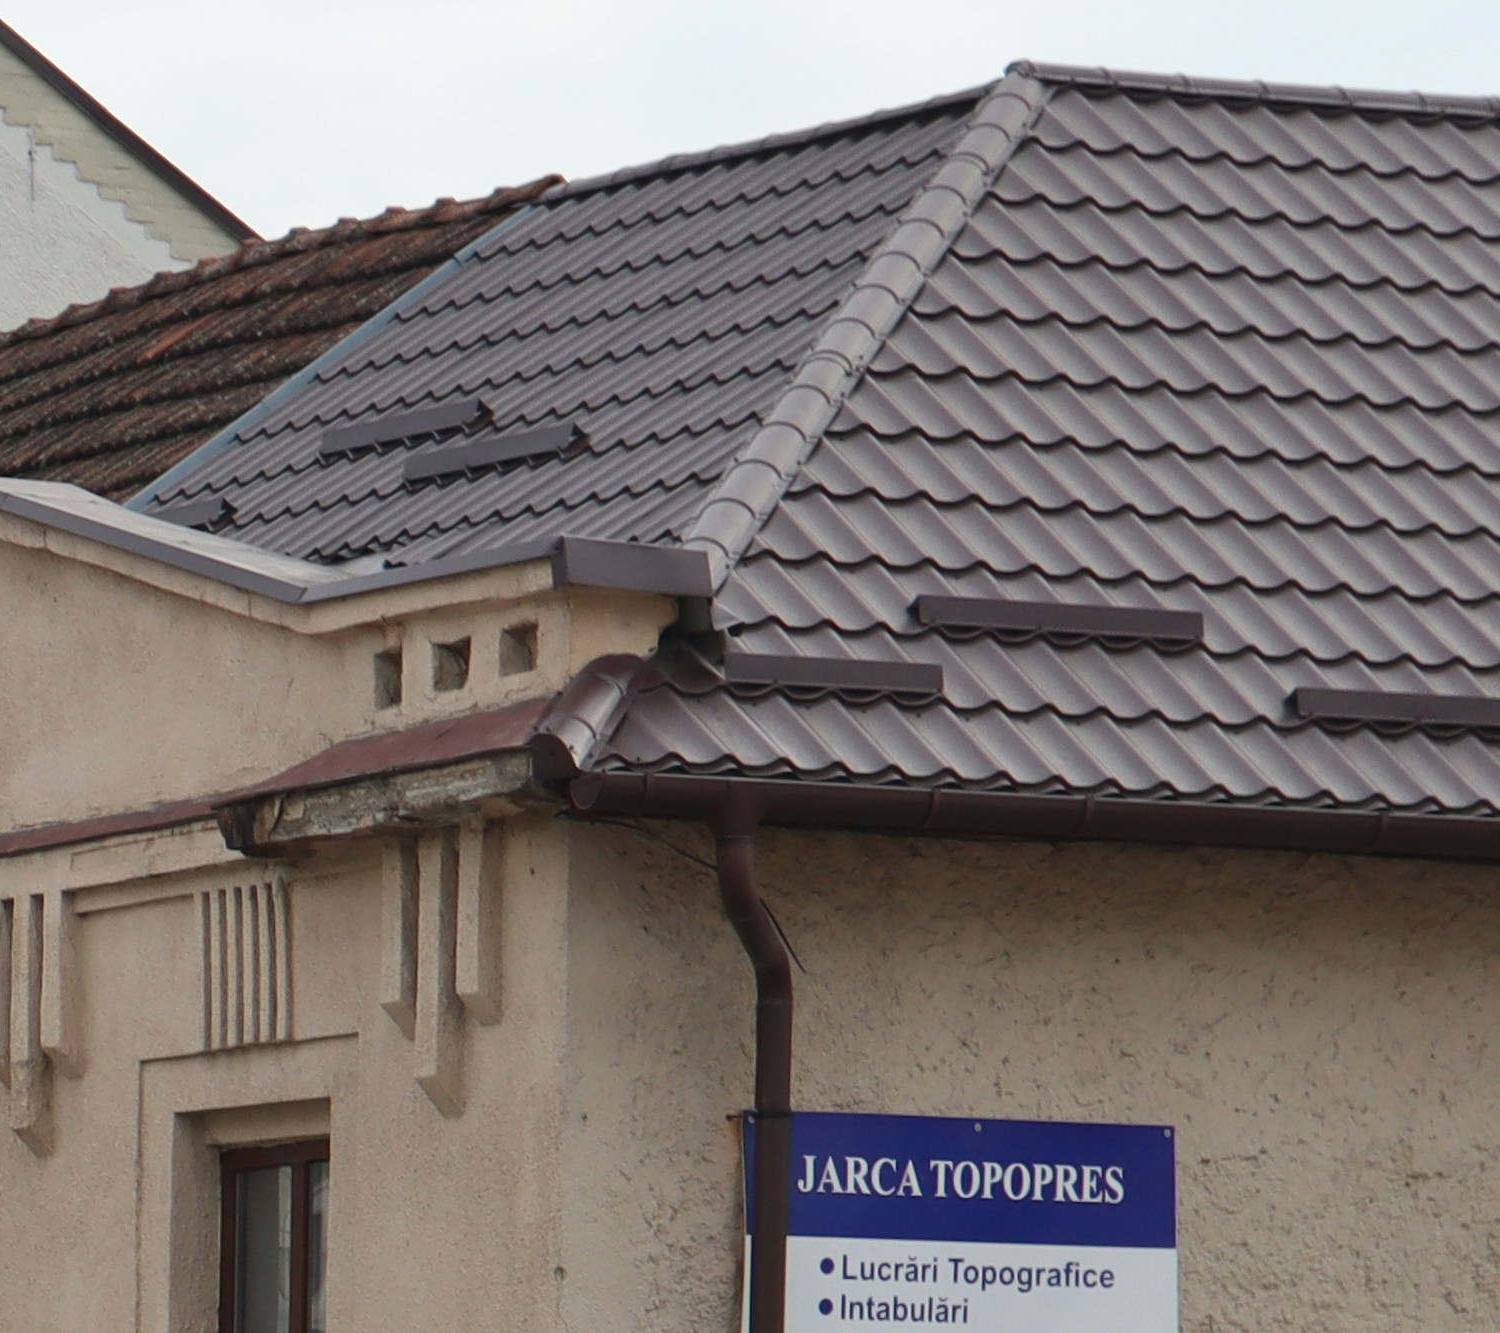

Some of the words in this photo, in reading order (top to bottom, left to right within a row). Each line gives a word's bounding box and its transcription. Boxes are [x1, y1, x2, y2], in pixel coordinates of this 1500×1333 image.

[797, 1154, 923, 1197] JARCA
[929, 1159, 1125, 1205] TOPOPRES
[841, 1254, 939, 1284] Lucrări
[948, 1257, 1116, 1294] Topografice
[839, 1294, 969, 1324] Intabulări
